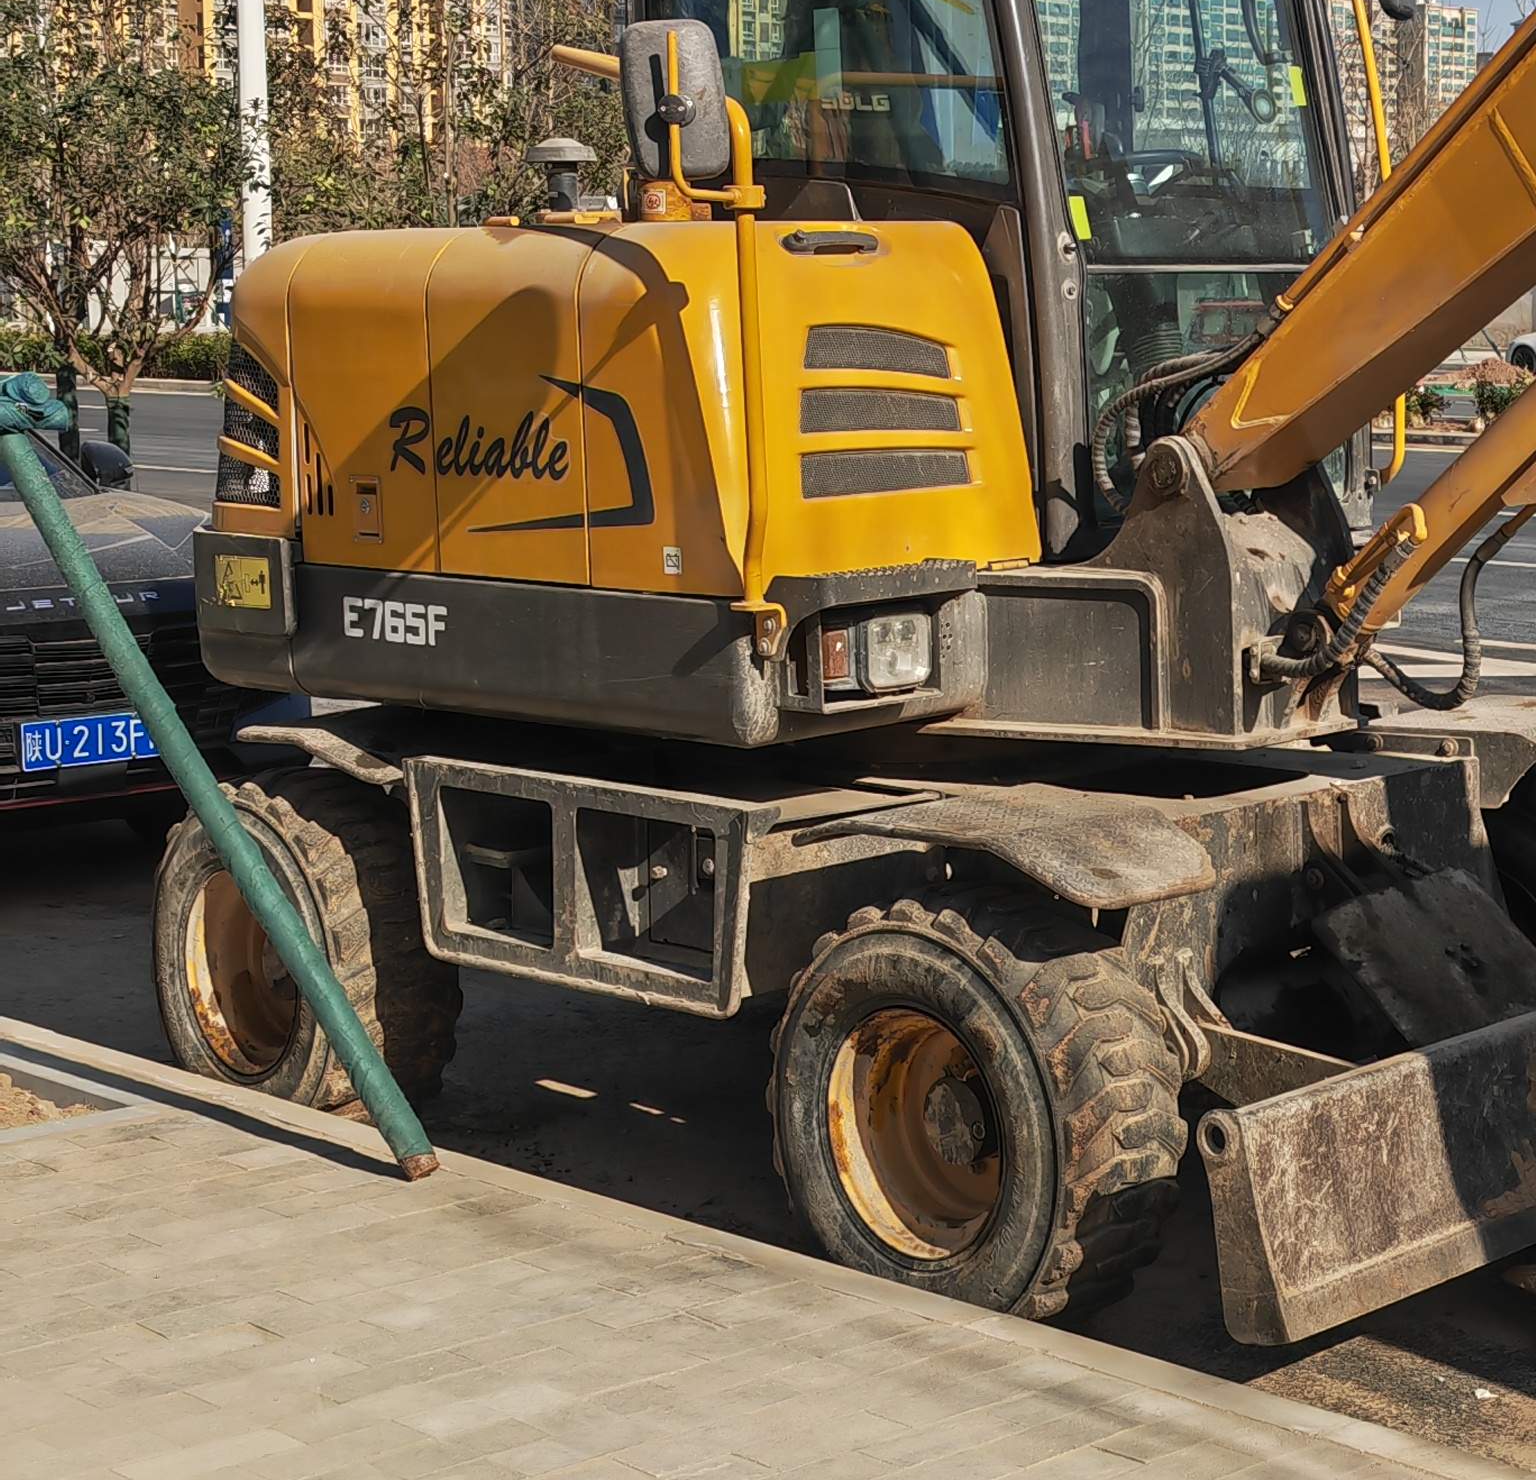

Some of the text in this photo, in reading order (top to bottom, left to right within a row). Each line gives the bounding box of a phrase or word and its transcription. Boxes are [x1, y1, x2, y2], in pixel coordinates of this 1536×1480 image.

[389, 406, 570, 481] Reliable
[6, 591, 161, 611] JETUR
[343, 596, 449, 647] E765F
[25, 719, 155, 763] 陕U·213F
